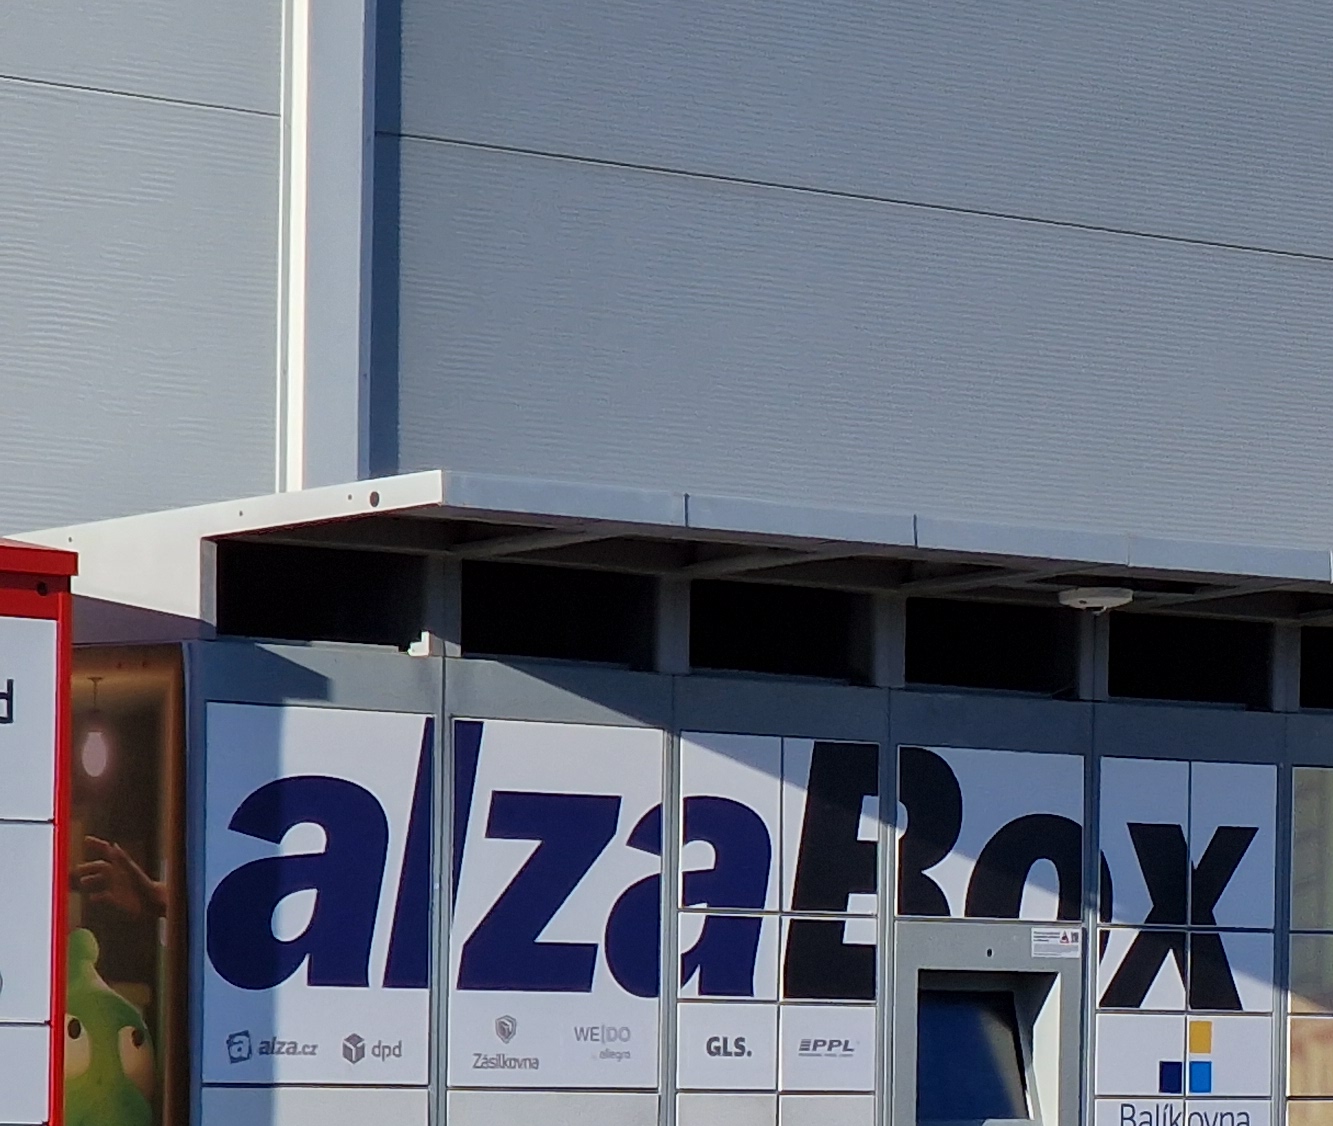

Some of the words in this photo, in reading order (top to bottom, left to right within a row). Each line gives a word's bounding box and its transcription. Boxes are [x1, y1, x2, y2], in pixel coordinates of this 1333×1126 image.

[206, 716, 1260, 1011] alzaBox
[258, 1036, 319, 1057] alza.cz
[371, 1039, 403, 1062] dpd
[472, 1052, 540, 1071] Zásilkovna
